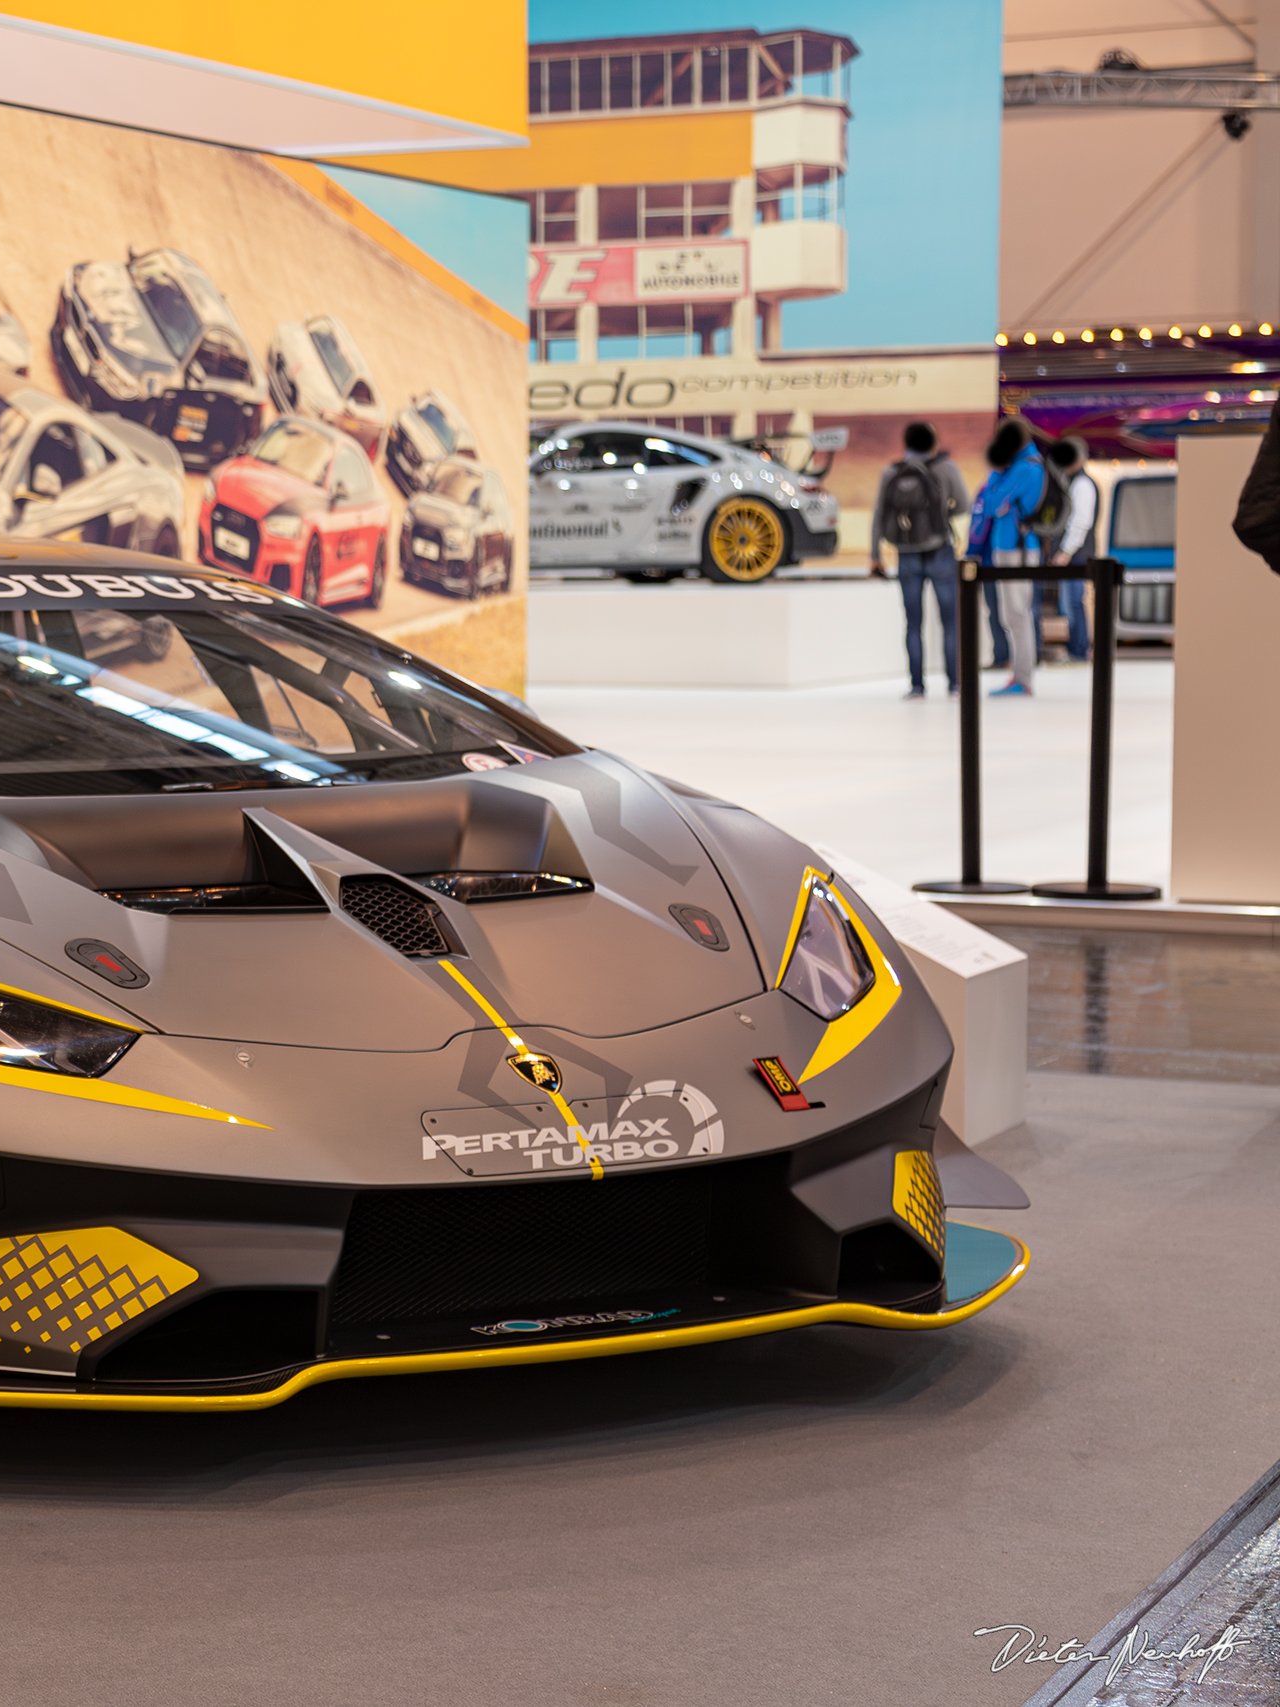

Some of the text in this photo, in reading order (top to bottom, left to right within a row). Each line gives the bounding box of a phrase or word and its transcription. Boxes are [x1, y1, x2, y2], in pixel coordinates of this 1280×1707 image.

[643, 273, 740, 291] AUTOMOBILE
[529, 366, 918, 411] edo competition
[765, 1060, 792, 1092] OMP
[422, 1117, 673, 1161] PERTAMAX
[523, 1139, 680, 1170] TURBO
[470, 1310, 654, 1336] KONRAD
